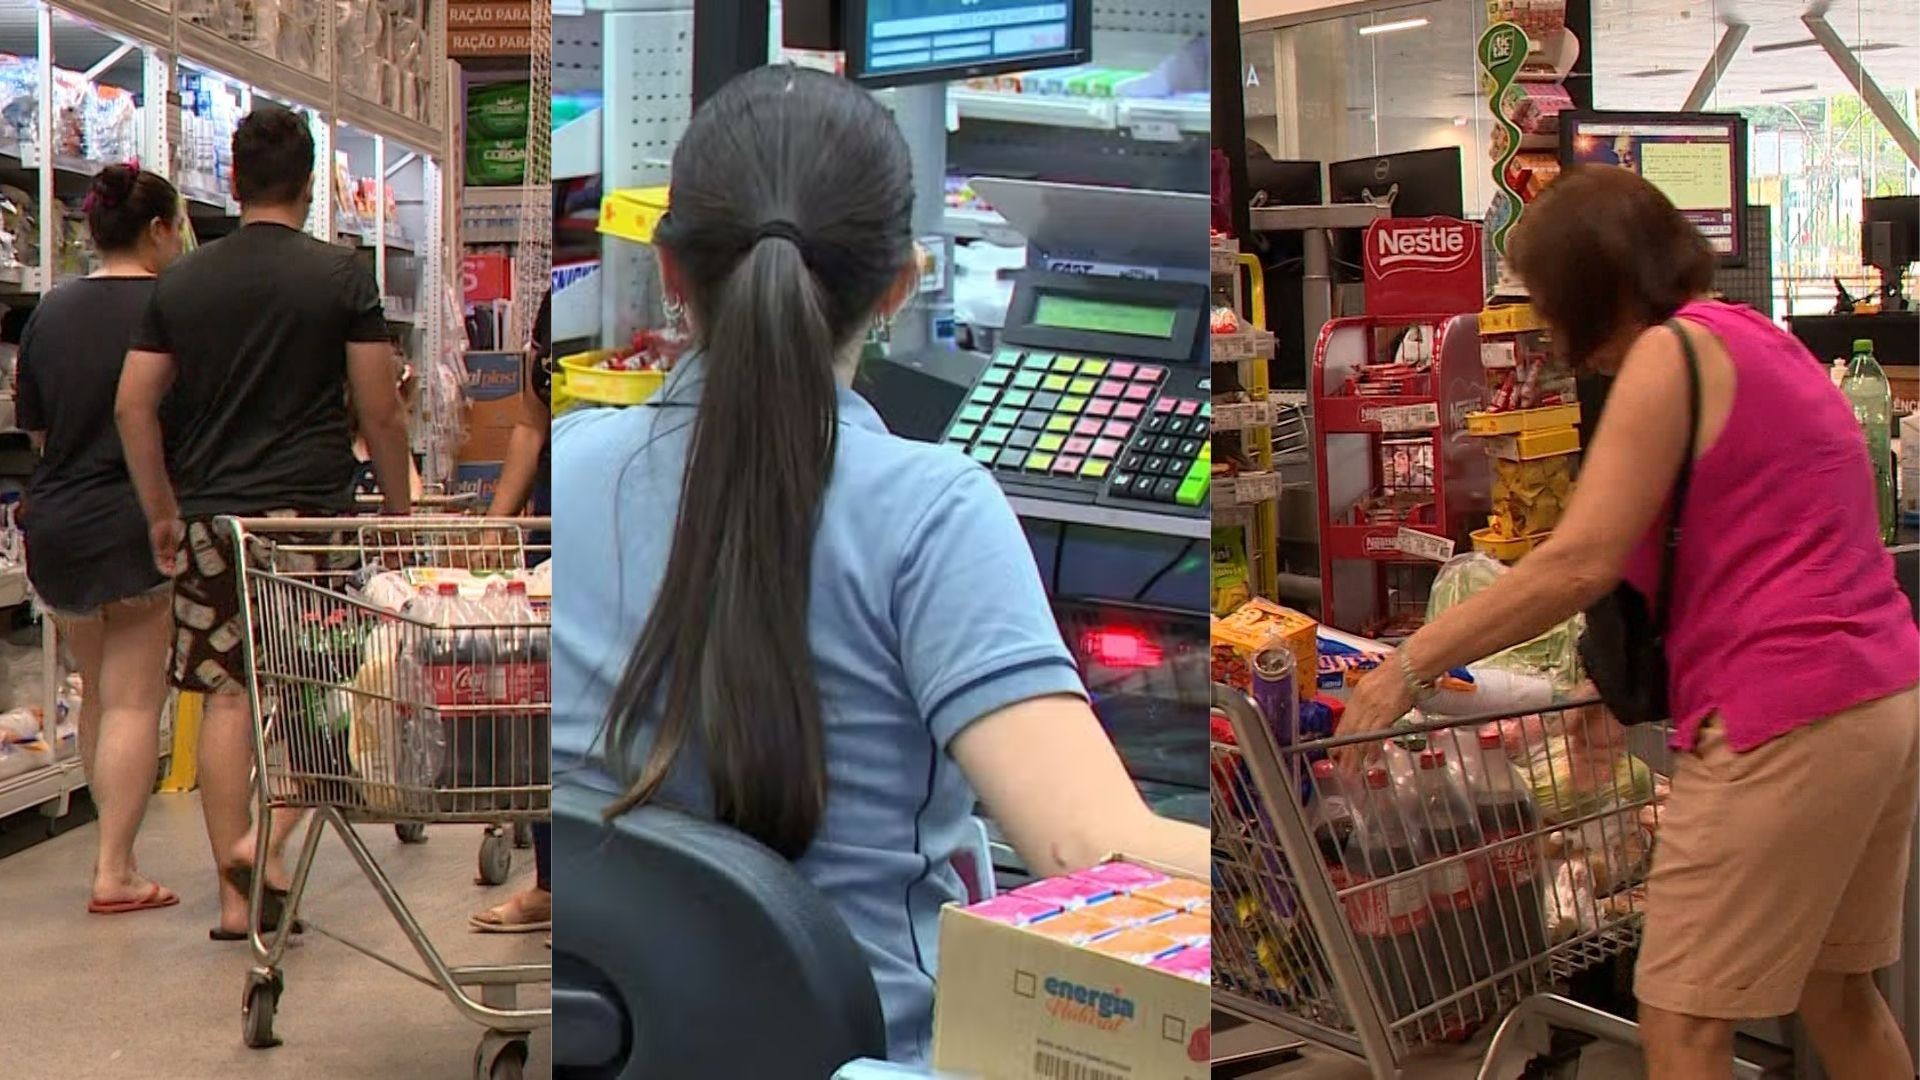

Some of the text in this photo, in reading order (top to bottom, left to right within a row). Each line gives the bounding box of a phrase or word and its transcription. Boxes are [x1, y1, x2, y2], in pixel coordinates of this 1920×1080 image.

[450, 6, 530, 24] RAÇÃO PARA
[453, 32, 496, 51] RAÇÃO
[1378, 227, 1464, 254] Nestlé
[1044, 977, 1134, 1019] energia
